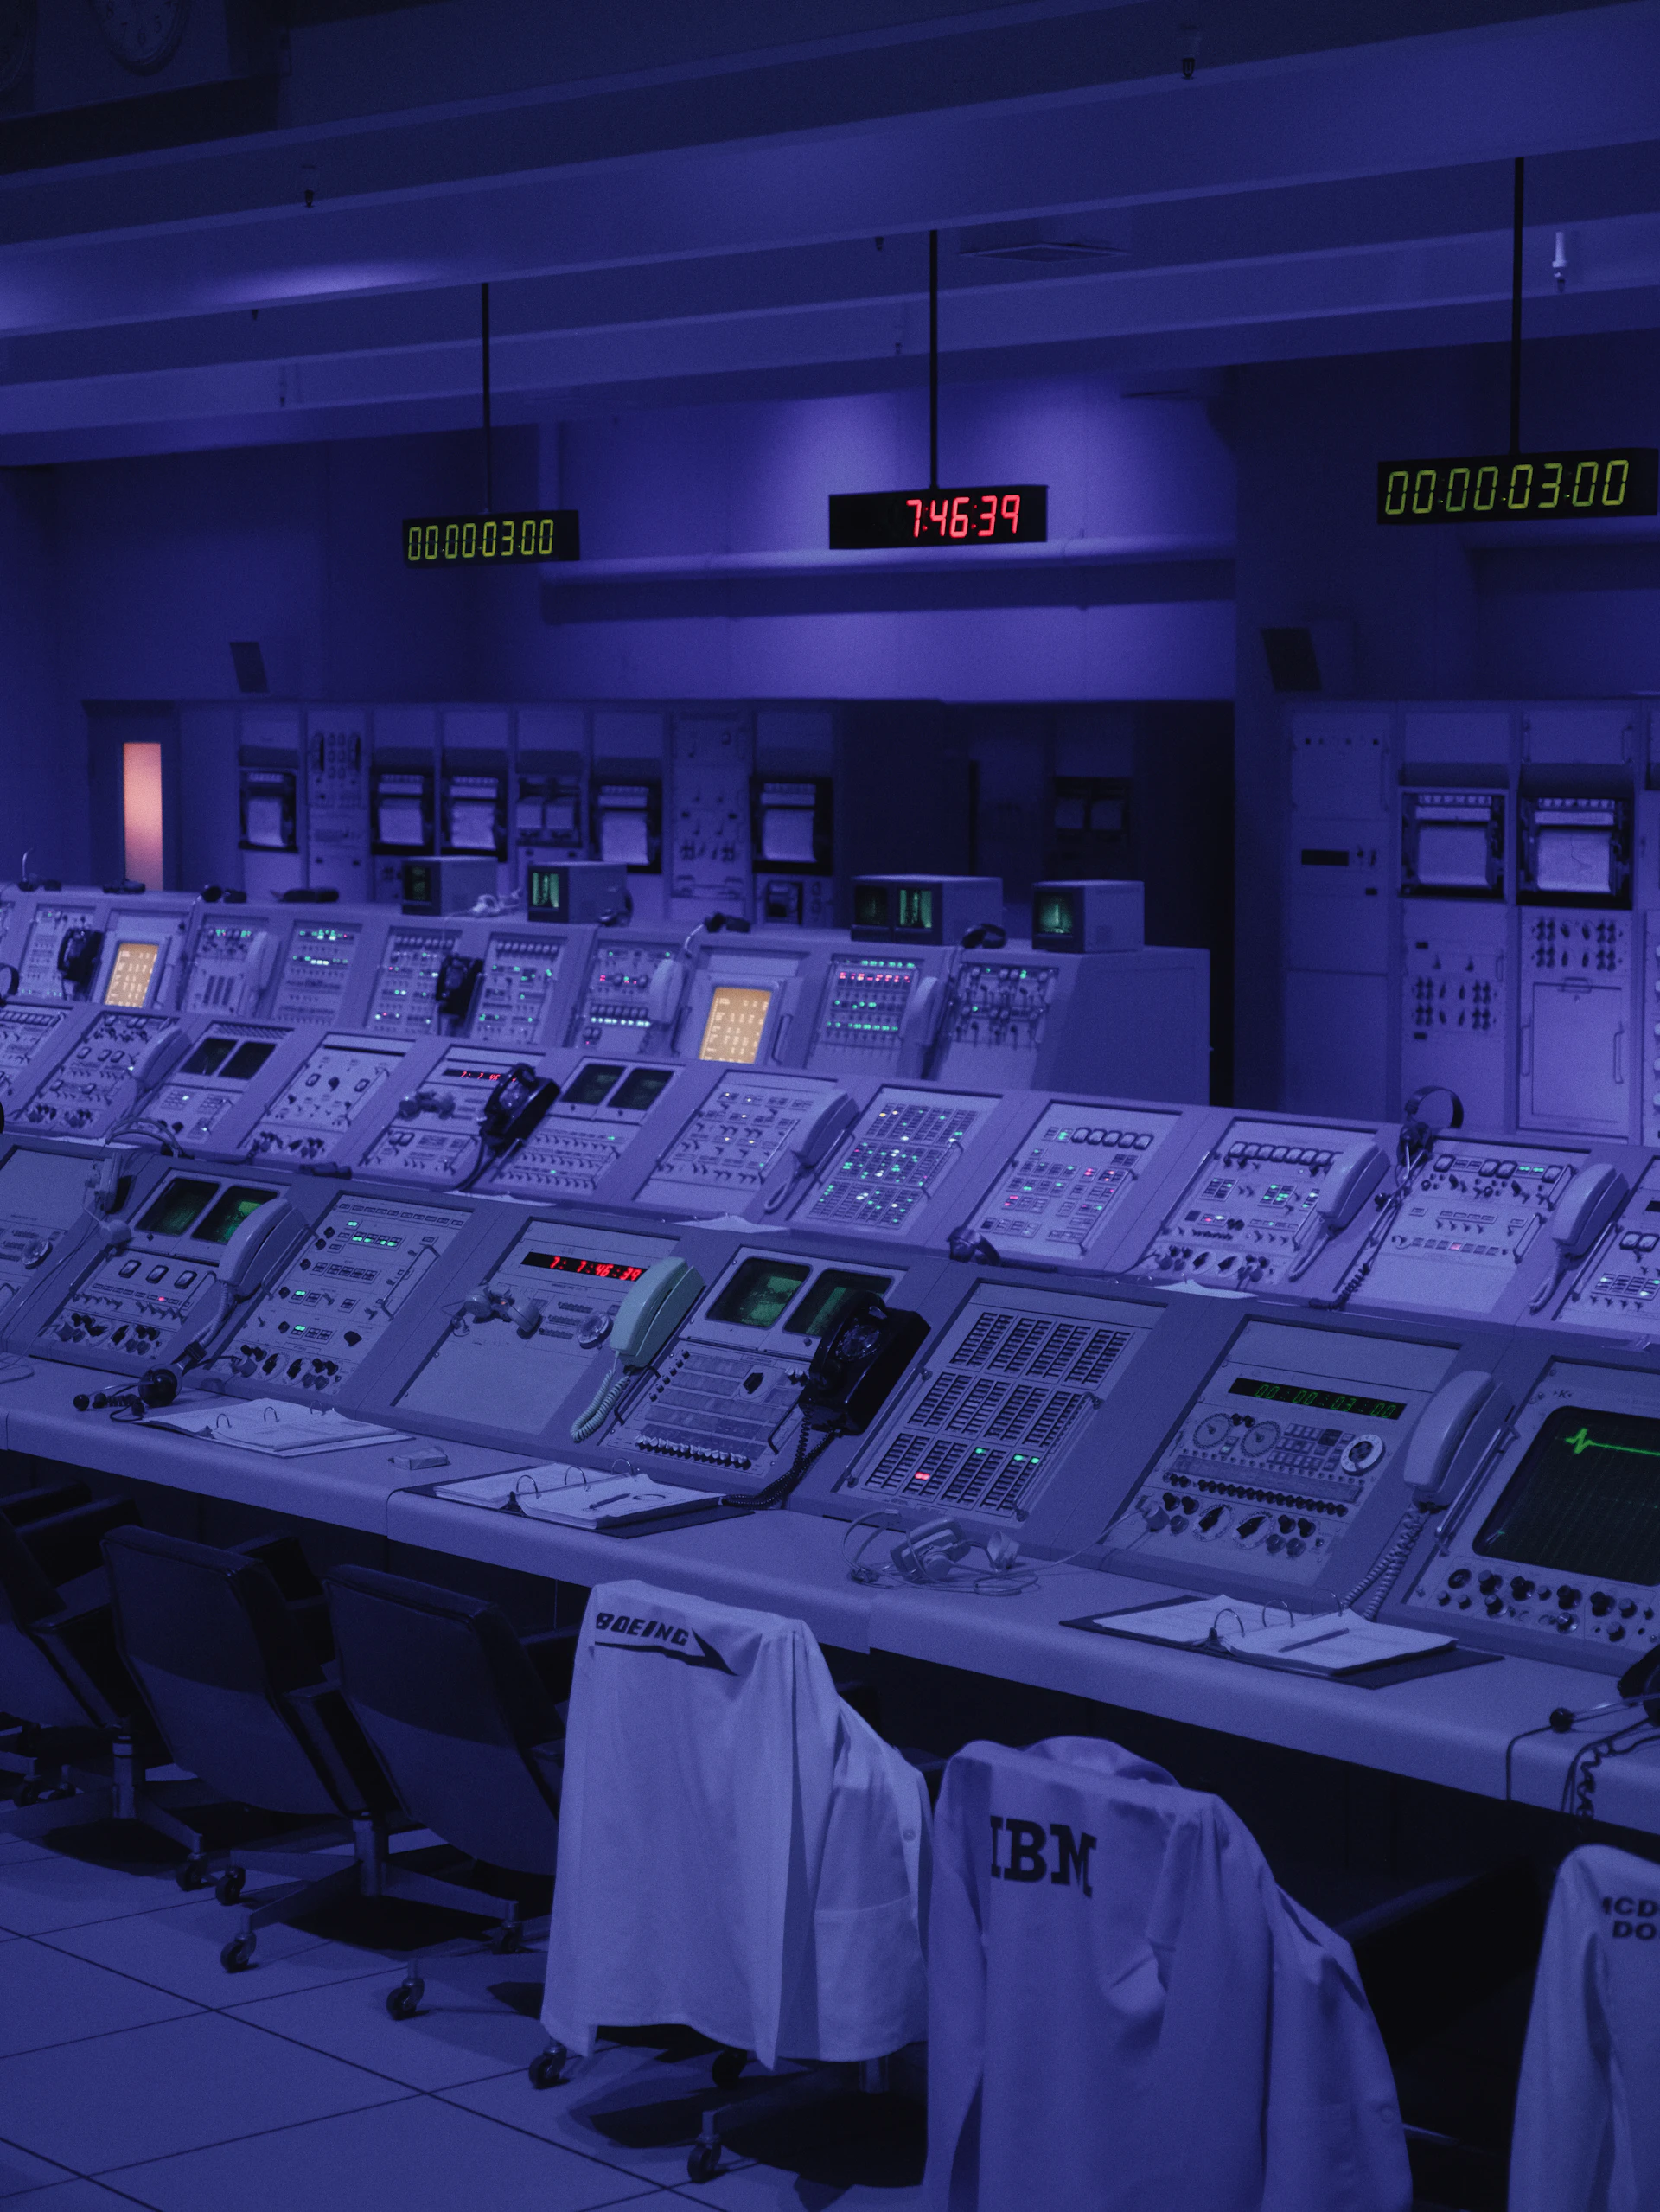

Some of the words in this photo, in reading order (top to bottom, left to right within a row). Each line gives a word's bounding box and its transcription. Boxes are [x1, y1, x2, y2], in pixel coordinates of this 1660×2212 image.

[905, 494, 1022, 539] 7:46:39
[595, 1612, 689, 1646] BOEING
[990, 1815, 1097, 1899] IBM
[1612, 1921, 1657, 1940] DO
